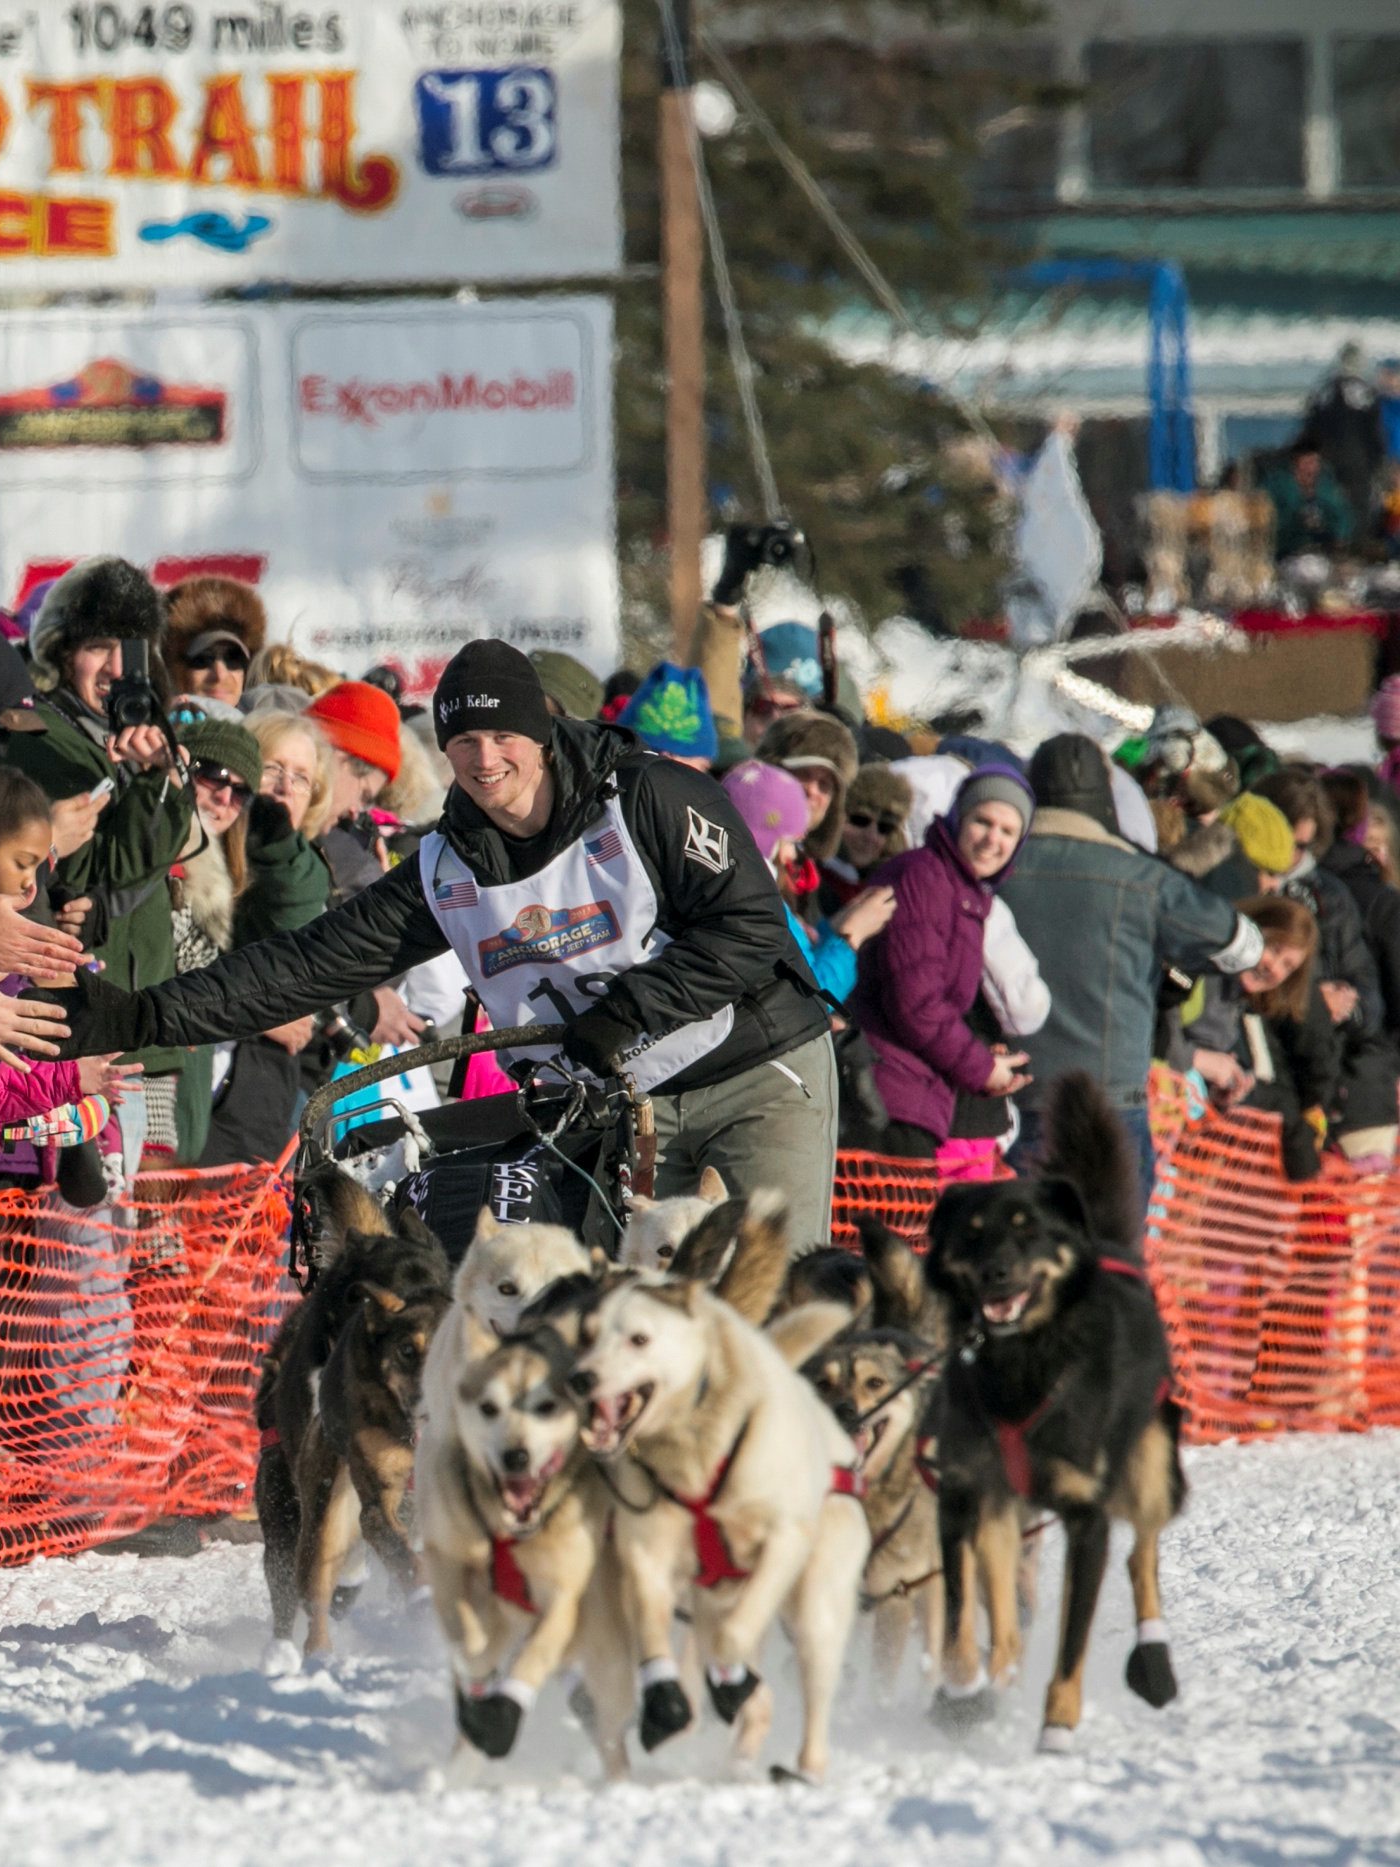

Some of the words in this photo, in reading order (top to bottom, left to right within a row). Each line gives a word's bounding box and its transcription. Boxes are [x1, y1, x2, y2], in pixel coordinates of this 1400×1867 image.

[68, 5, 193, 55] 1049
[214, 6, 347, 54] miles
[422, 70, 554, 170] 13
[24, 70, 398, 215] TRAIL
[299, 372, 575, 428] ExxonMobil
[466, 694, 500, 708] Keller
[498, 923, 593, 961] ANCHORAGE
[518, 908, 552, 942] 50
[590, 929, 610, 943] RAM
